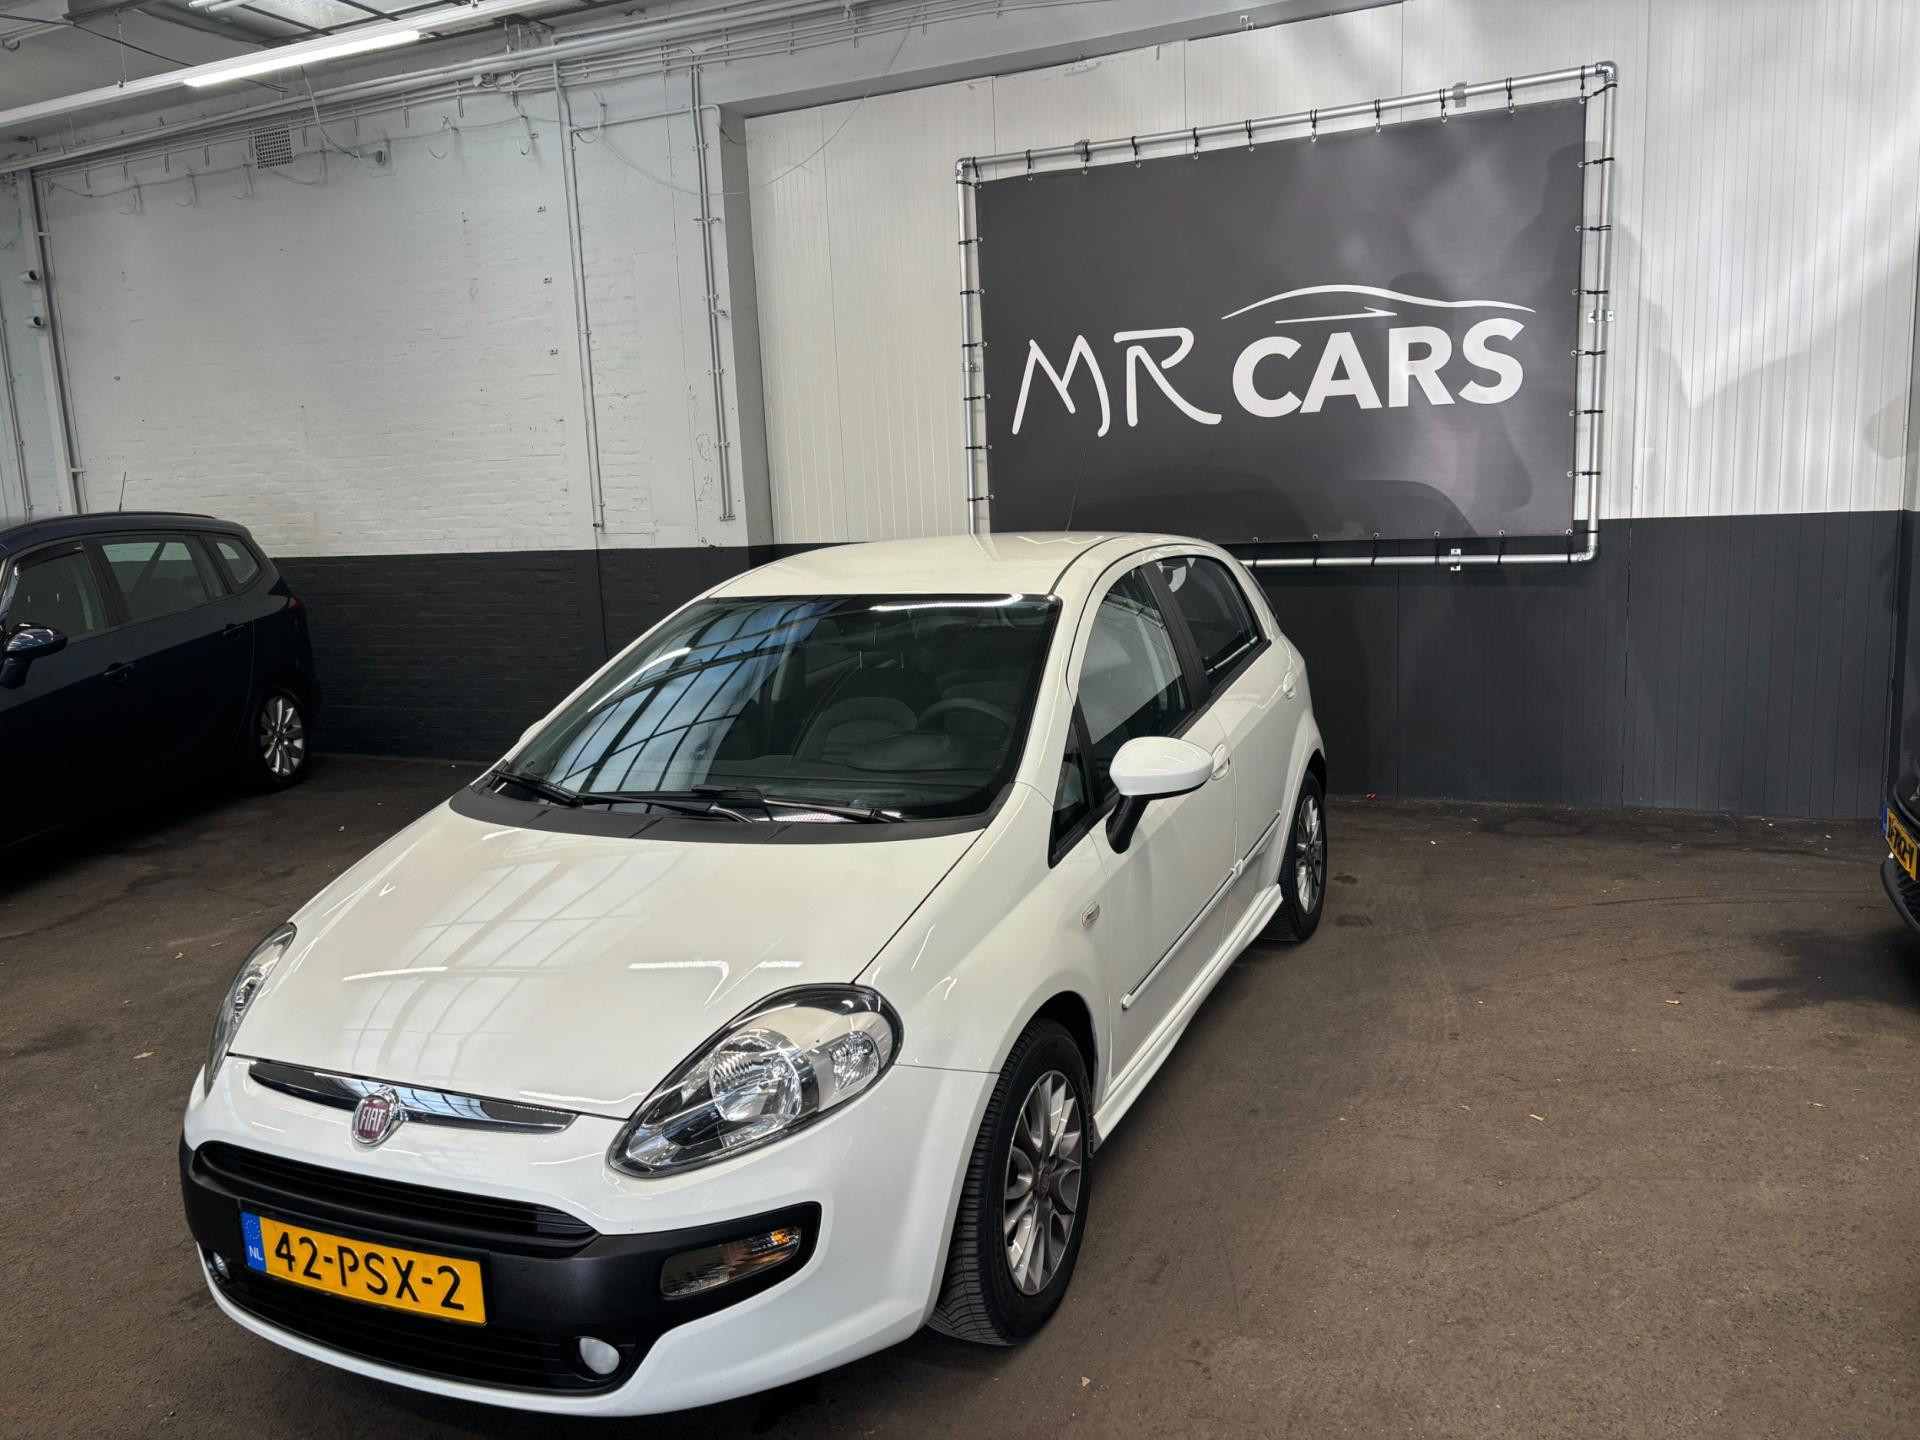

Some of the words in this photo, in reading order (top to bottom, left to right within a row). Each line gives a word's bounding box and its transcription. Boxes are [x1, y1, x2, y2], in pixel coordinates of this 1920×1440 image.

[1011, 327, 1222, 438] MR
[1232, 317, 1525, 418] CARS
[360, 1106, 386, 1131] FIAT
[248, 1245, 263, 1262] NL
[275, 1231, 464, 1311] 42-PSX-2
